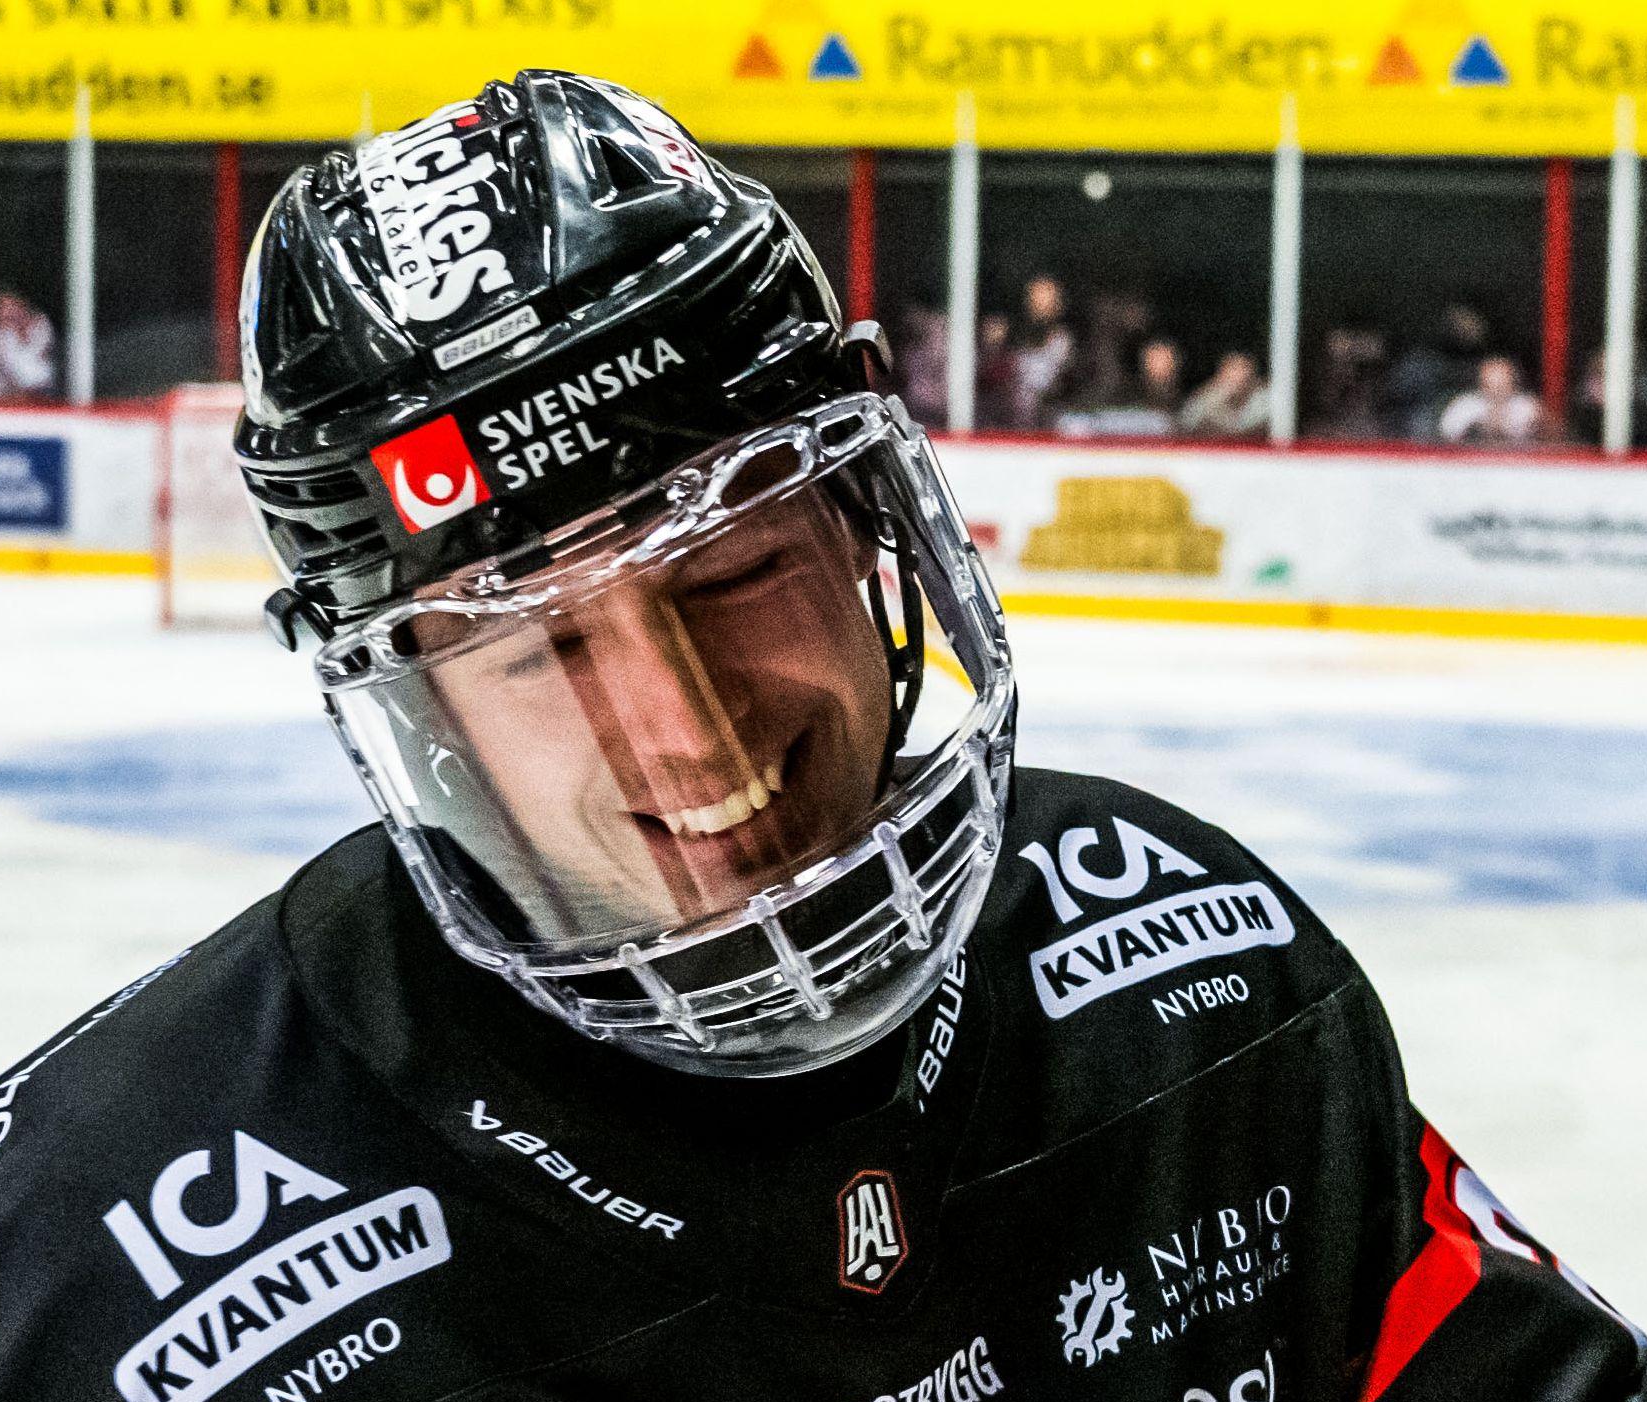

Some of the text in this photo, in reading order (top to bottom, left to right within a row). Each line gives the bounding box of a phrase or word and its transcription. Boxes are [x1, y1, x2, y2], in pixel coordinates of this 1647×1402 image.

[884, 14, 1338, 88] Ramudden
[479, 336, 685, 453] SVENSKA
[496, 421, 612, 491] SPEL
[1018, 815, 1209, 925] ICA
[1039, 889, 1277, 999] KVANTUM
[1151, 972, 1250, 1025] NYBRO
[102, 1128, 351, 1302] ICA
